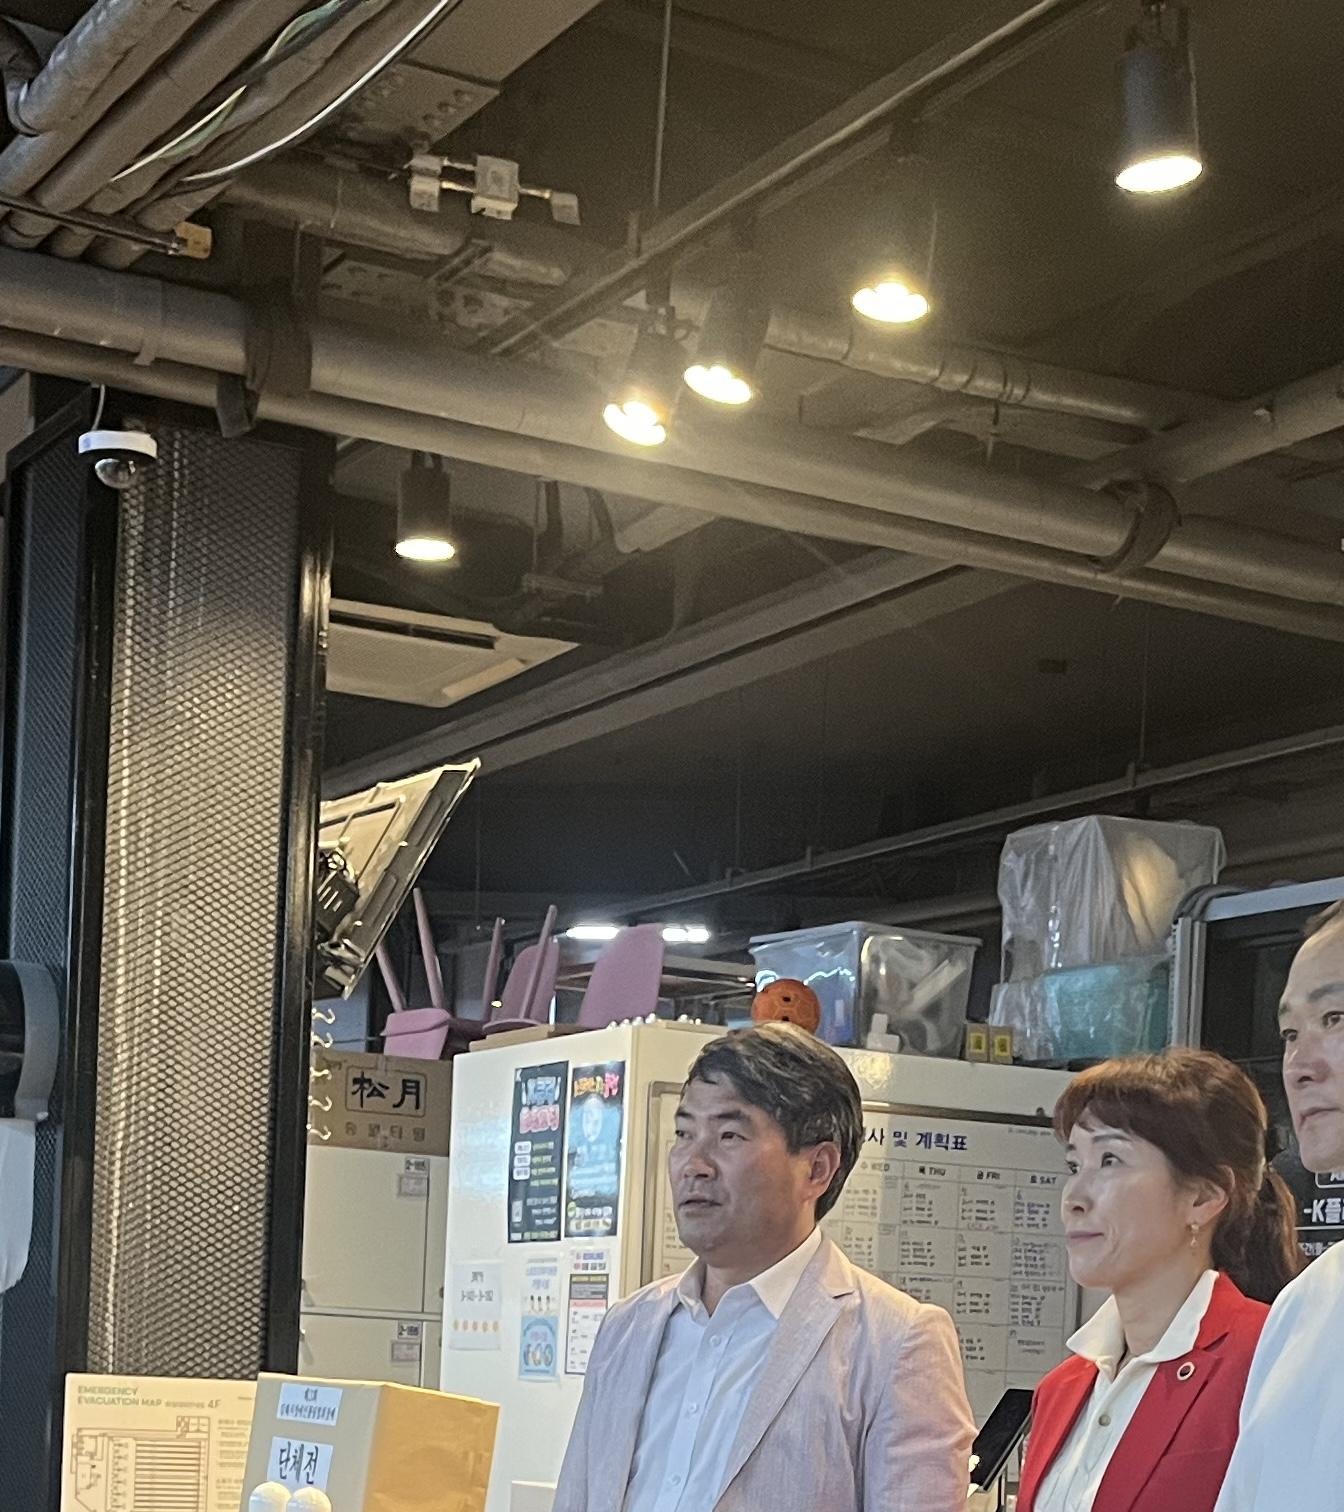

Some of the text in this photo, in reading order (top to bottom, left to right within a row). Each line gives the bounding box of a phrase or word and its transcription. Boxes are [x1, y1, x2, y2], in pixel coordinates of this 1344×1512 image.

[352, 1071, 421, 1110] 松月
[863, 1127, 968, 1151] 사 및 계획표
[928, 1166, 946, 1177] THU
[986, 1171, 1001, 1180] FRI
[1039, 1176, 1057, 1185] SAT
[78, 1385, 138, 1396] EMERGENCY
[78, 1396, 140, 1408] EVACUATION
[142, 1399, 162, 1408] MAP
[207, 1399, 221, 1409] 4F
[278, 1441, 319, 1485] 단체전
